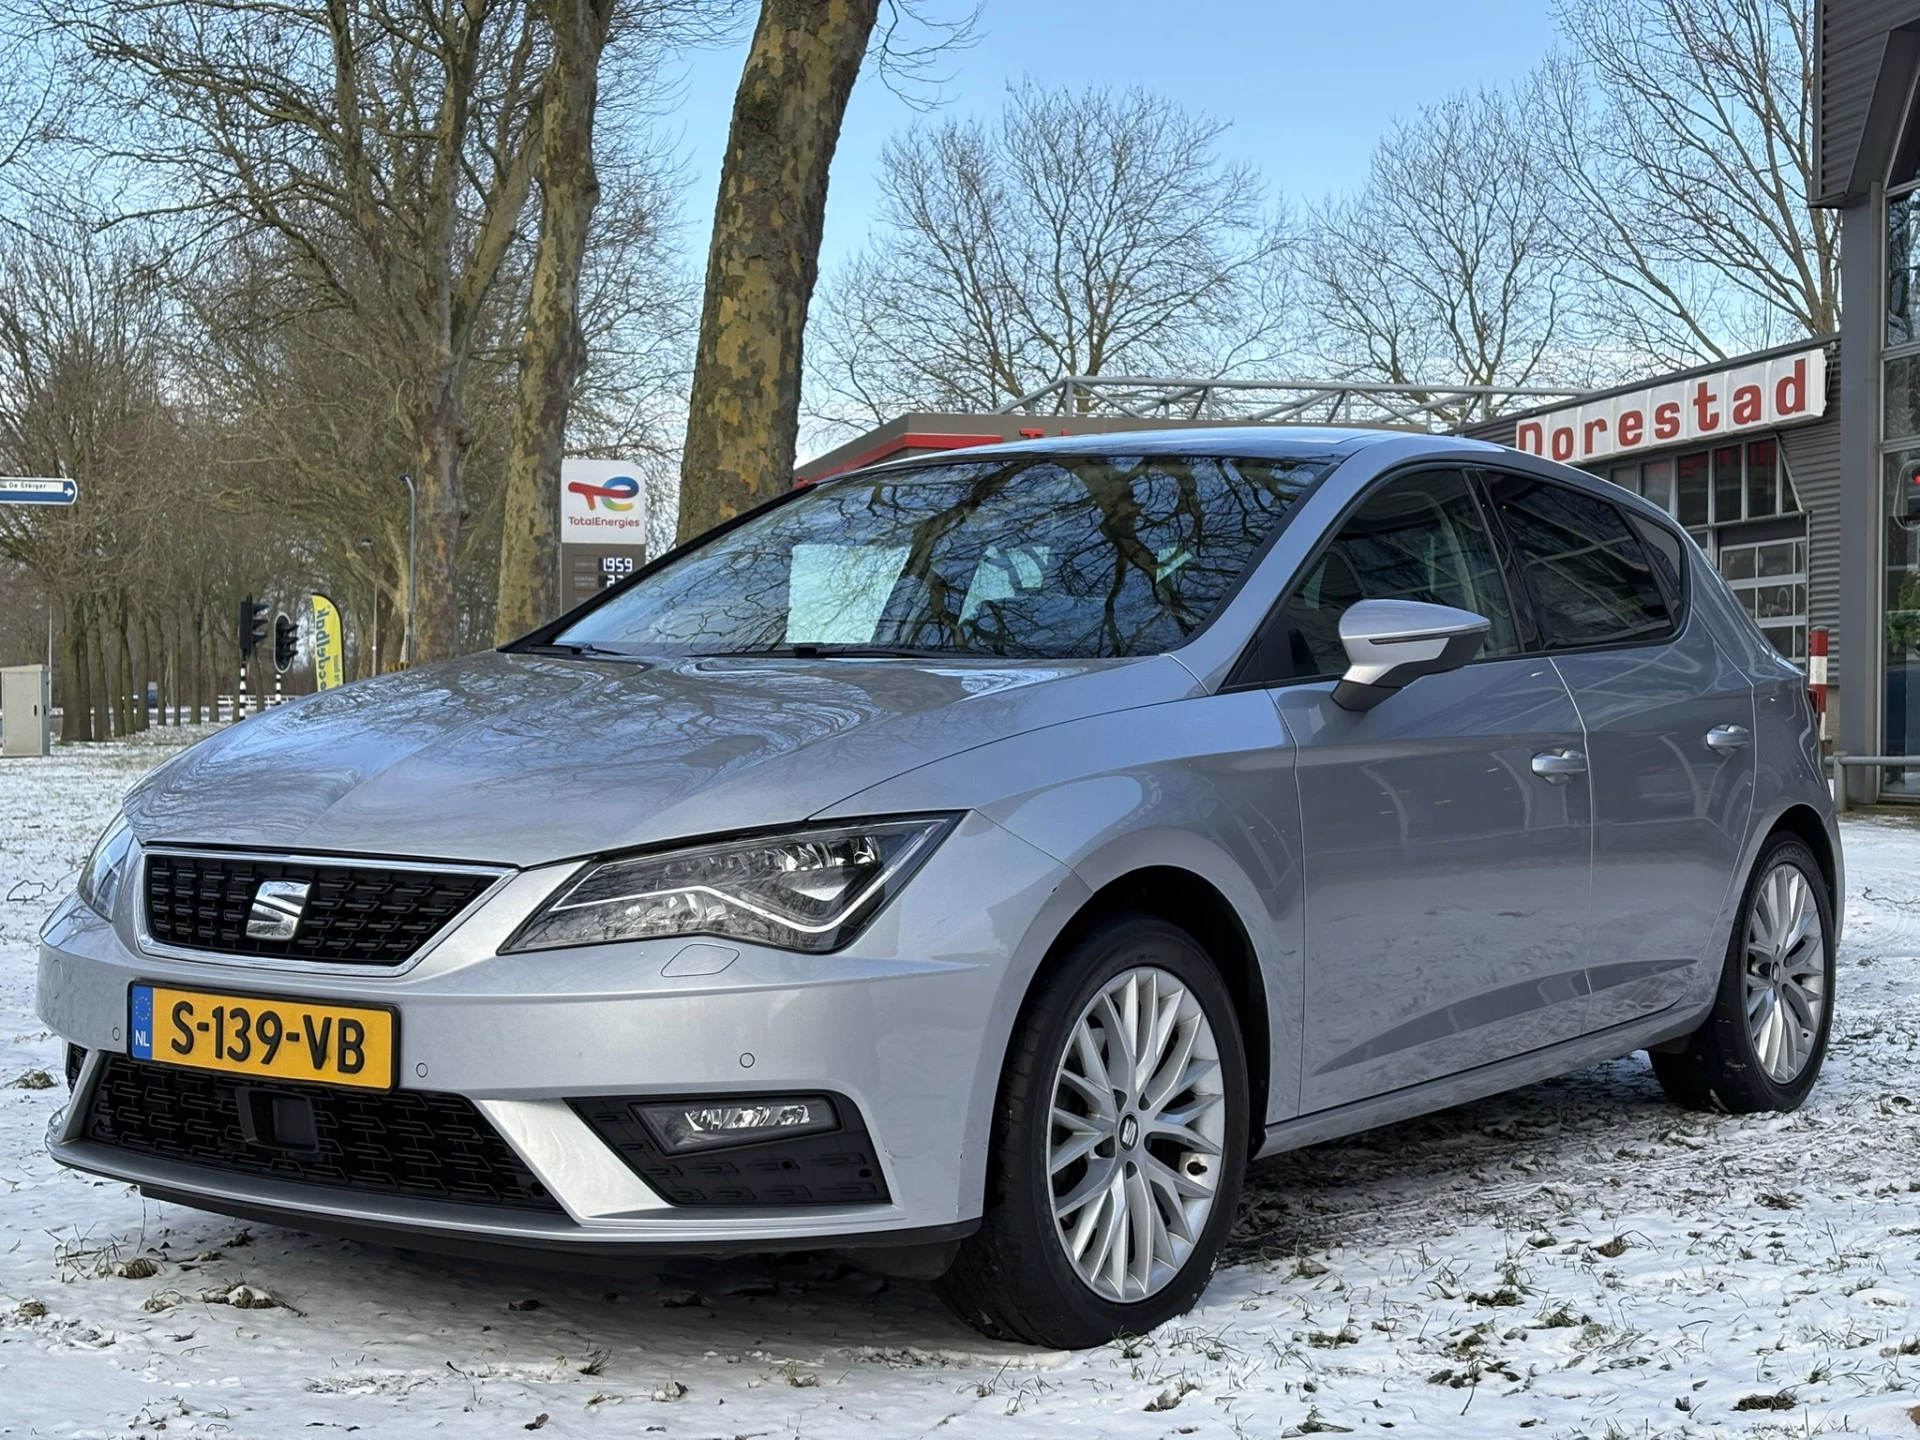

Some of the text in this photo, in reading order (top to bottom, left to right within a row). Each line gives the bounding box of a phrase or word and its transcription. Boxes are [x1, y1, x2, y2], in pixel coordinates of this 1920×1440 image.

[1518, 358, 1806, 462] Dorestad
[568, 516, 640, 529] TotalEnergies
[135, 1030, 150, 1048] NL
[171, 1000, 366, 1075] S-139-VB
